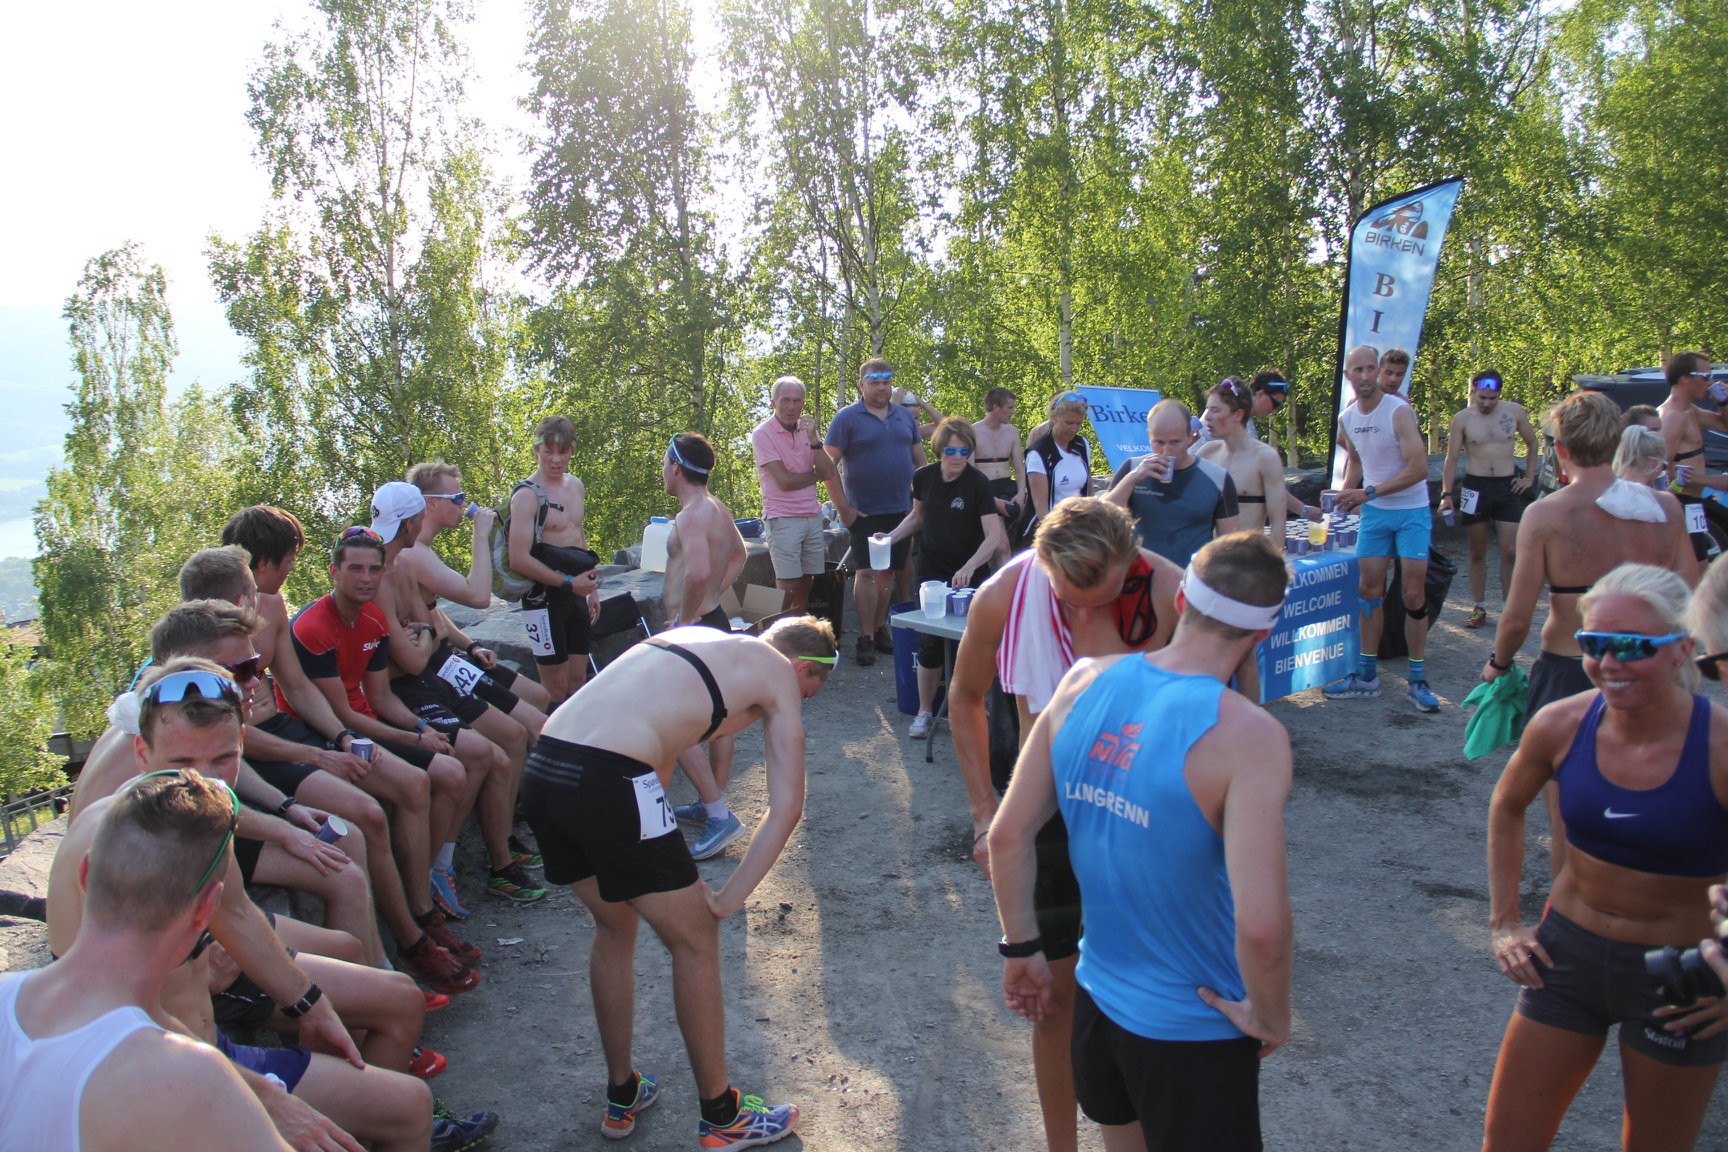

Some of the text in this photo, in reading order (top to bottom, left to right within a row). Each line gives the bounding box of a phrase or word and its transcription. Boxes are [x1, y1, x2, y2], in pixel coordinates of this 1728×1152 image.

[1364, 232, 1426, 256] BIRKEN
[1354, 426, 1374, 434] CRAFT
[1288, 561, 1349, 591] LKOMMEN
[1283, 590, 1342, 619] WELCOME
[525, 623, 541, 644] 37
[1270, 614, 1351, 649] WILLKOMMEN
[1274, 642, 1345, 675] BIENVENUE
[1065, 781, 1149, 829] LANGRENN
